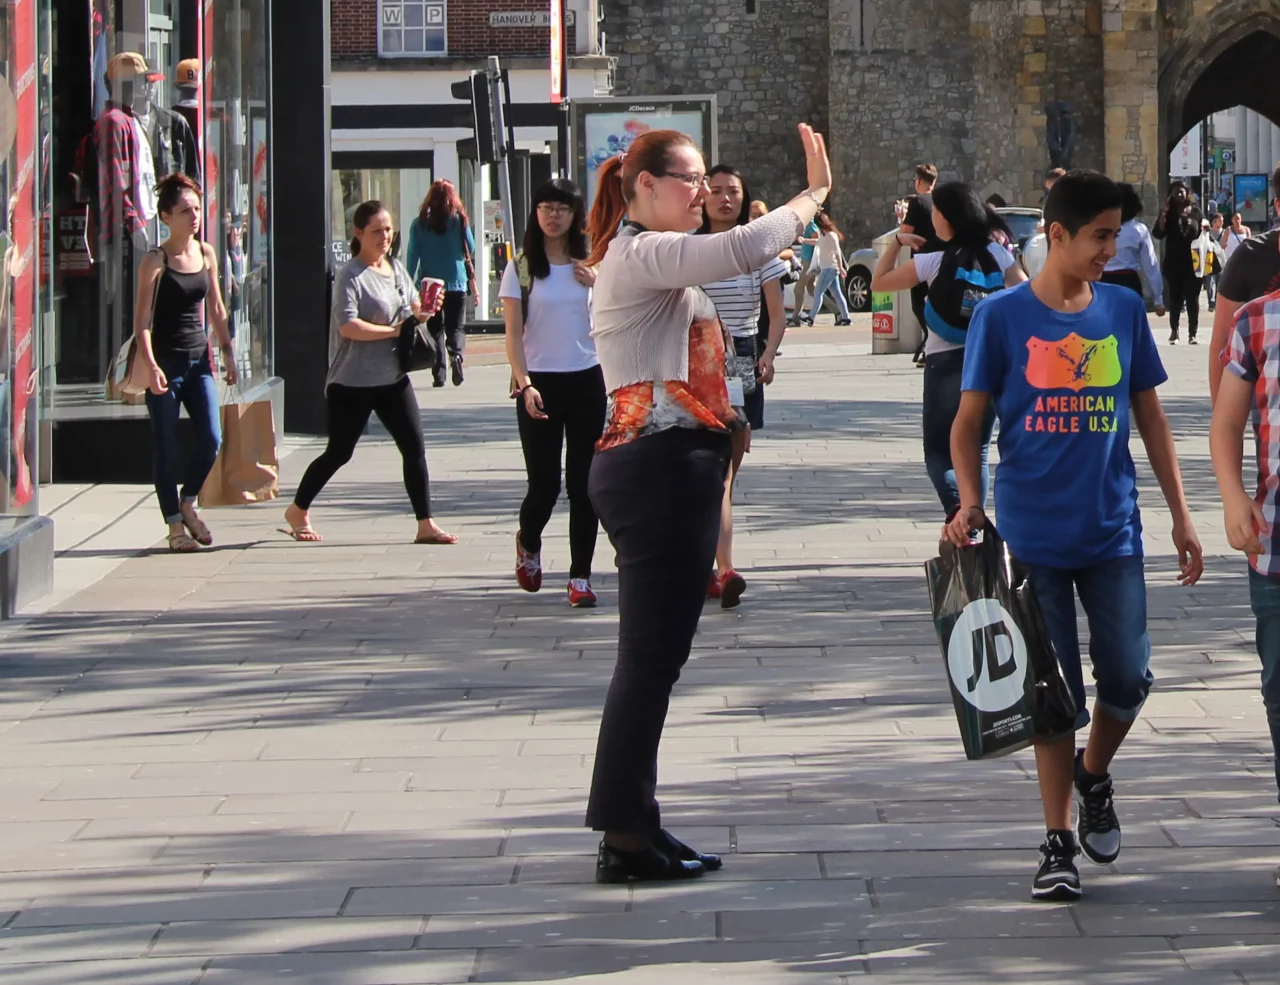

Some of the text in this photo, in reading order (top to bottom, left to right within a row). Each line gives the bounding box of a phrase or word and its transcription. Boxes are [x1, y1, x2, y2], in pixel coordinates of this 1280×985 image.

[491, 15, 536, 24] HANOVER
[1034, 395, 1115, 413] AMERICAN
[1024, 415, 1080, 433] EAGLE
[966, 620, 1018, 693] JD
